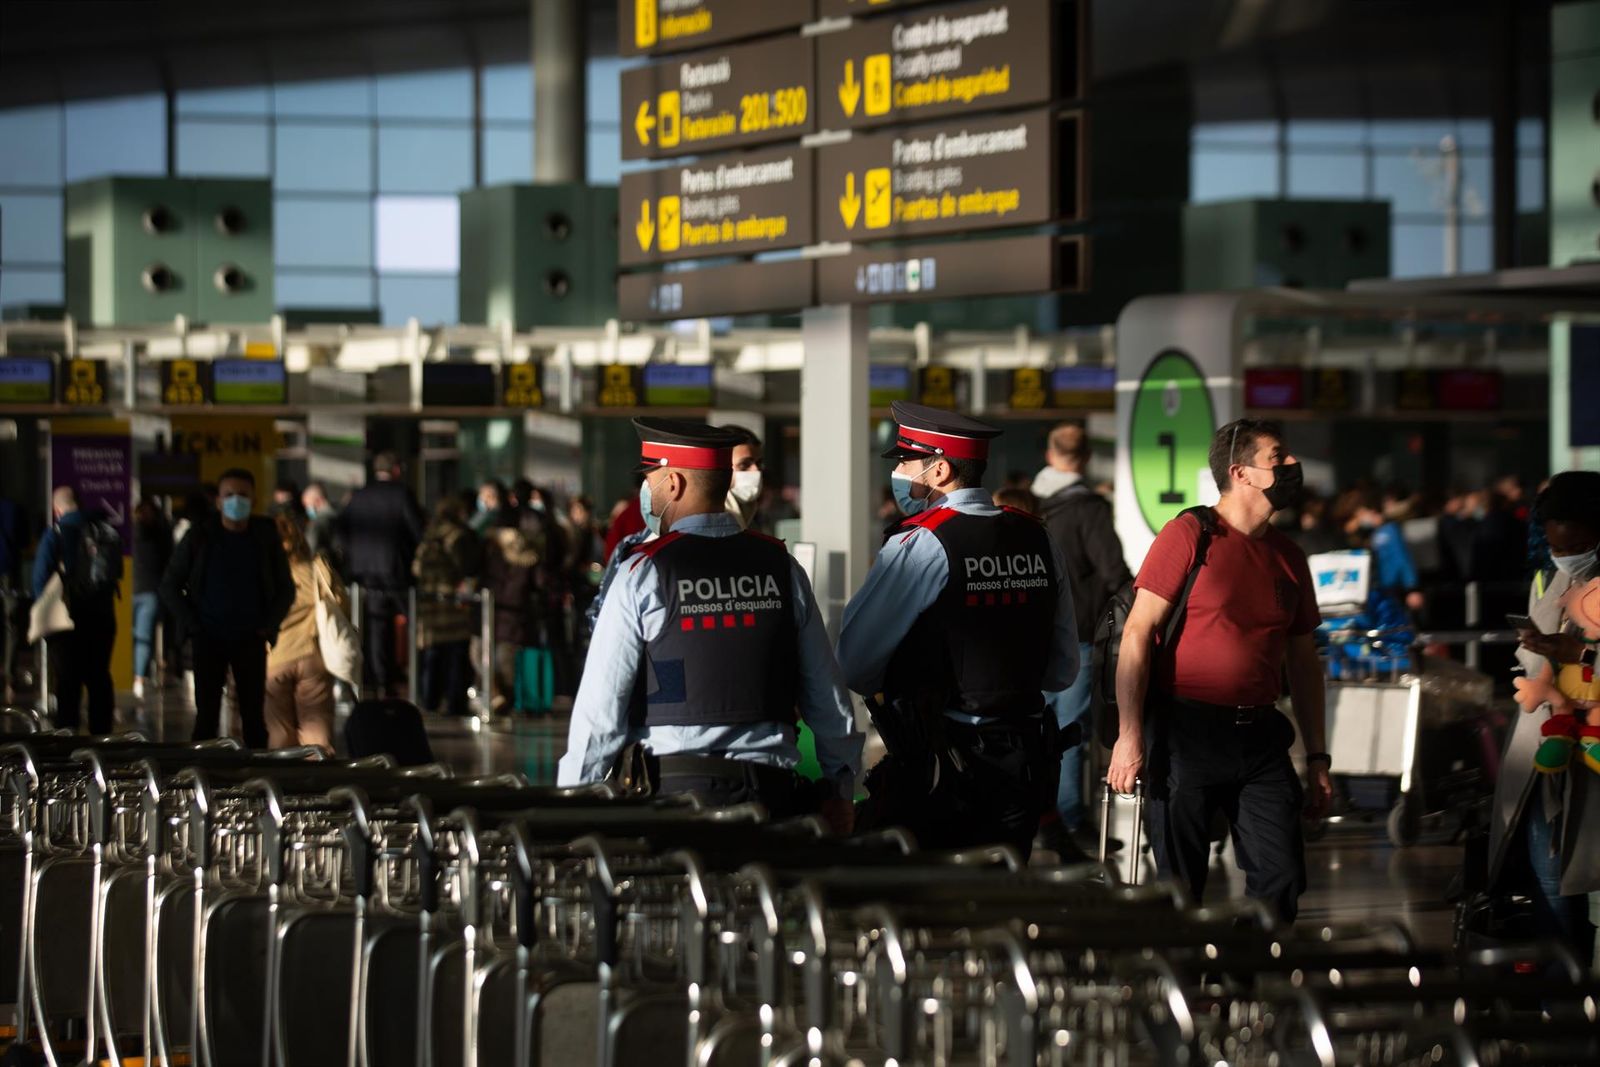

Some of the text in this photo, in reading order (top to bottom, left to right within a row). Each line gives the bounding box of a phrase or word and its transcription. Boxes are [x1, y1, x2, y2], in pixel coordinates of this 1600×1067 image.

[893, 17, 936, 51] Control
[894, 186, 1020, 223] Puertas de embarque
[682, 220, 720, 246] Puertas
[964, 554, 1047, 578] POLICIA
[677, 574, 781, 602] POLICIA
[967, 576, 1049, 592] mossos d'esquadra
[681, 598, 782, 615] mossos d'esquadra
